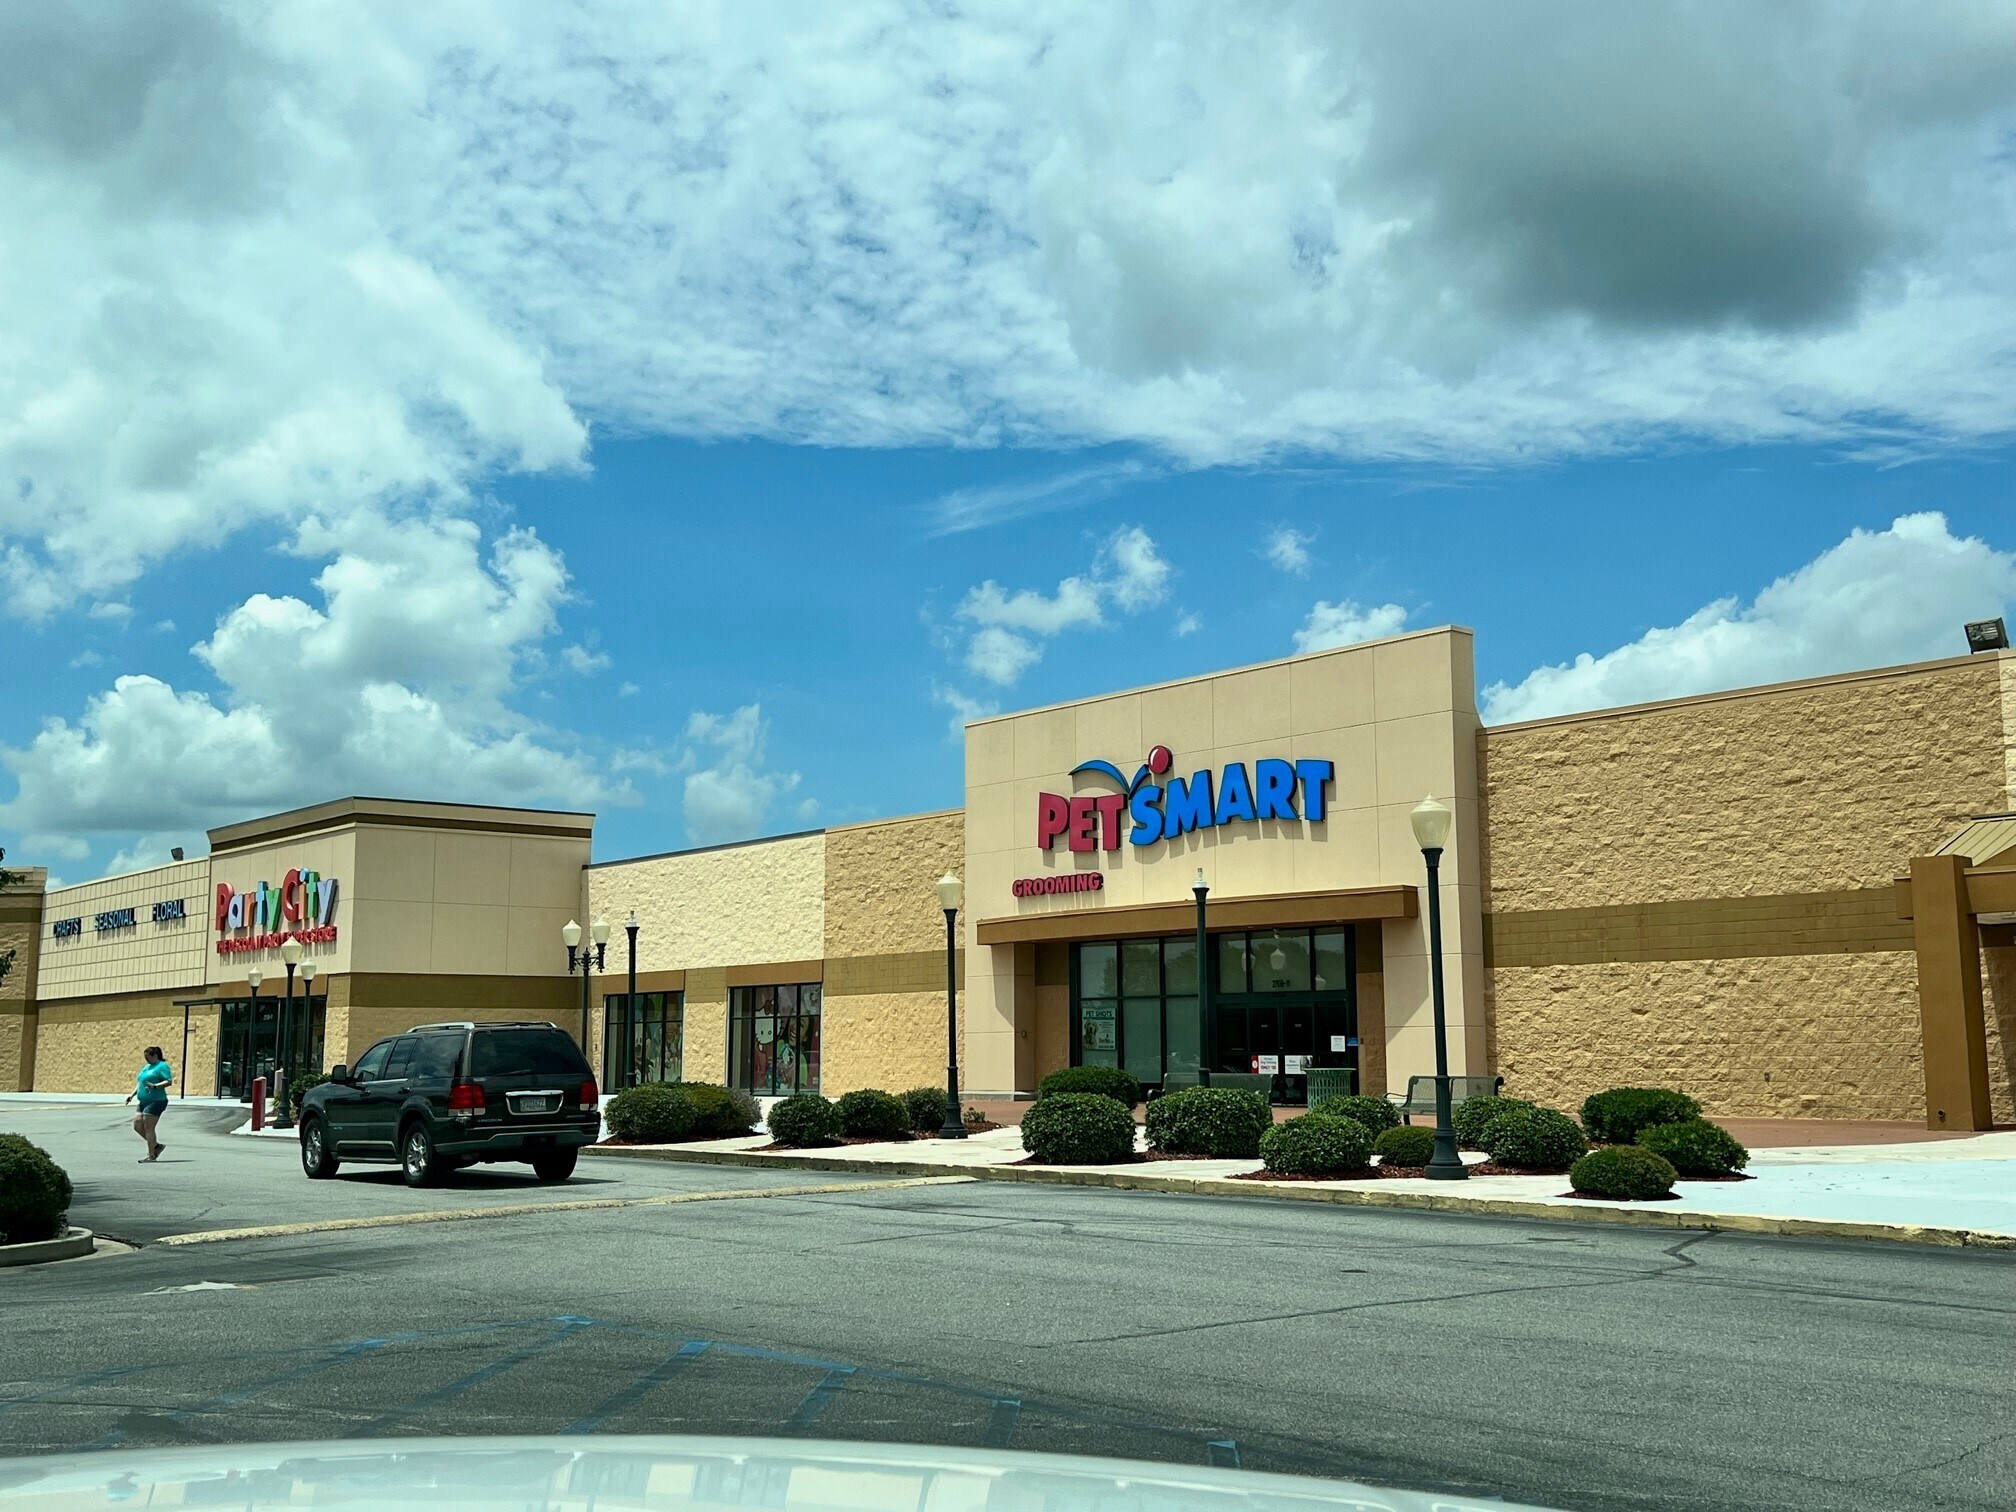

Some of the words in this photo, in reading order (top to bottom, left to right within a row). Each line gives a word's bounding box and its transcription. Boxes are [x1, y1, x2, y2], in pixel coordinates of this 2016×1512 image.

[1011, 872, 1104, 898] GROOMING
[94, 908, 137, 931] SEASONAL
[152, 899, 186, 921] FLORAL
[53, 917, 82, 938] CRAFTS
